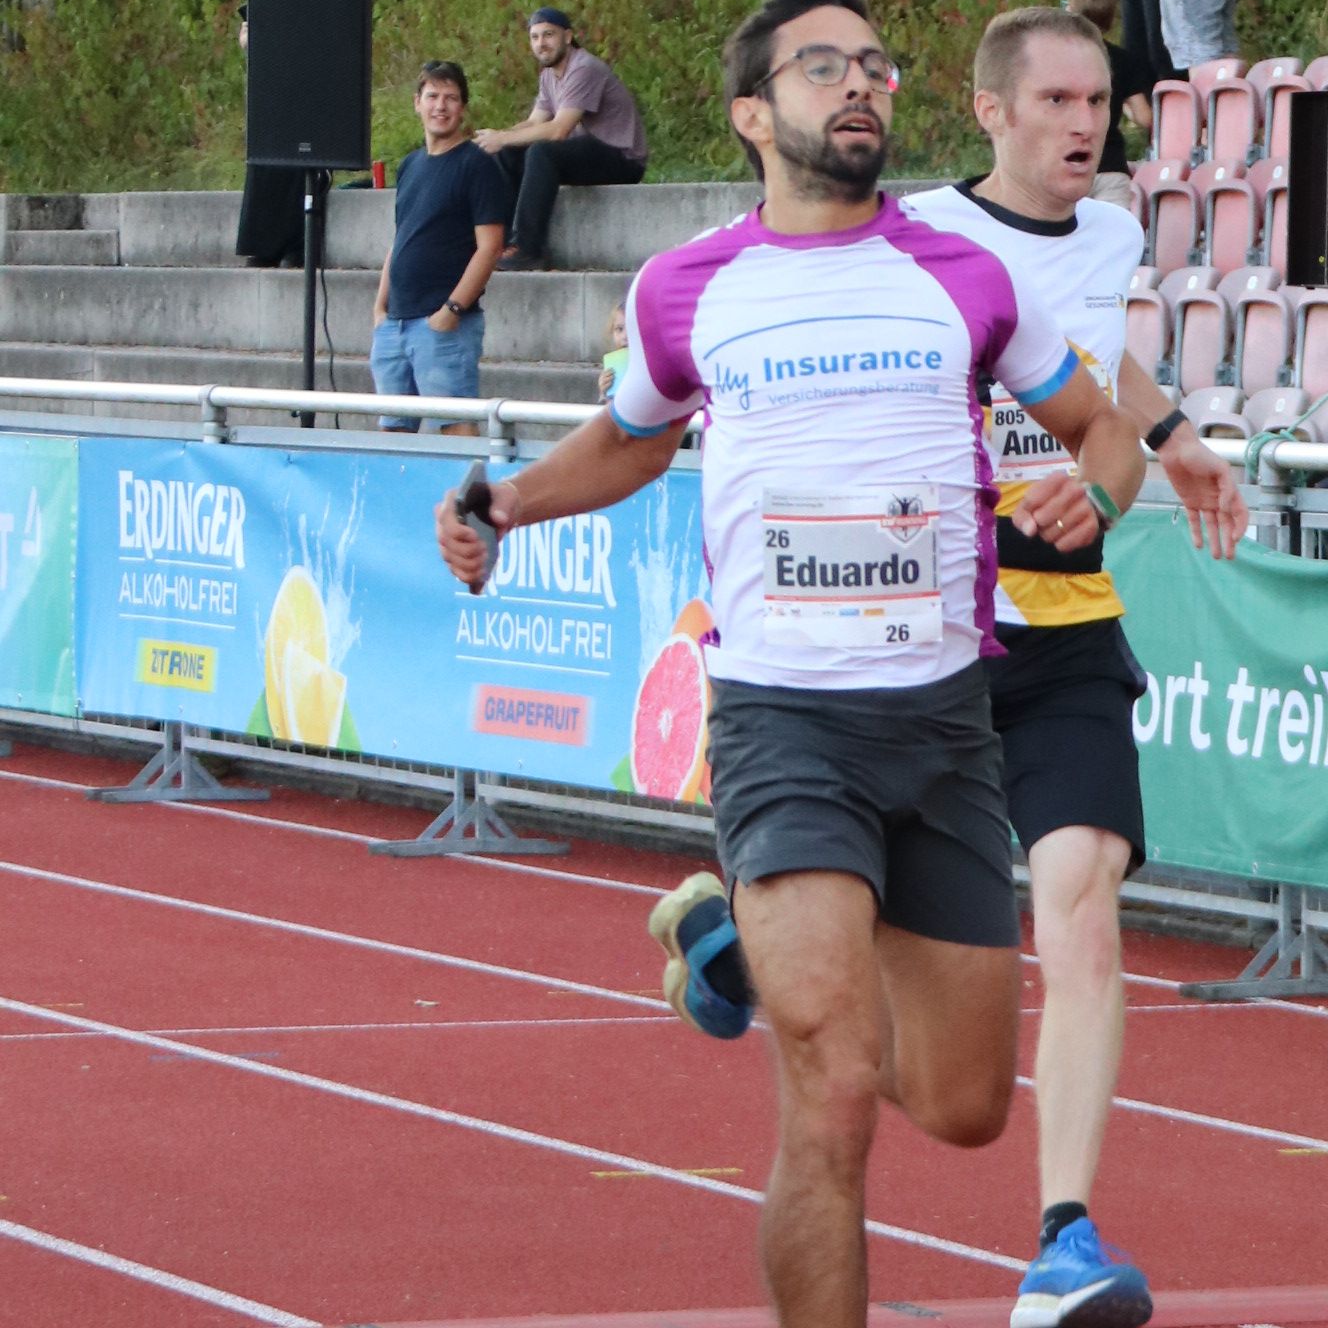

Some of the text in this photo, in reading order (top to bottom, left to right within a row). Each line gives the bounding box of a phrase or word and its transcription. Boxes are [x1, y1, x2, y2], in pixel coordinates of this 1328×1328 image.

[763, 349, 943, 383] Insurance
[995, 409, 1025, 426] 805
[118, 470, 247, 569] ERDINGER
[765, 529, 790, 548] 26
[486, 513, 617, 608] DINGER
[776, 552, 920, 588] Eduardo
[119, 572, 238, 615] ALKOHOLFREI
[455, 608, 612, 660] ALKOHOLFREI
[885, 623, 910, 643] 26
[484, 696, 581, 732] GRAPEFRUIT
[1132, 661, 1211, 750] ort
